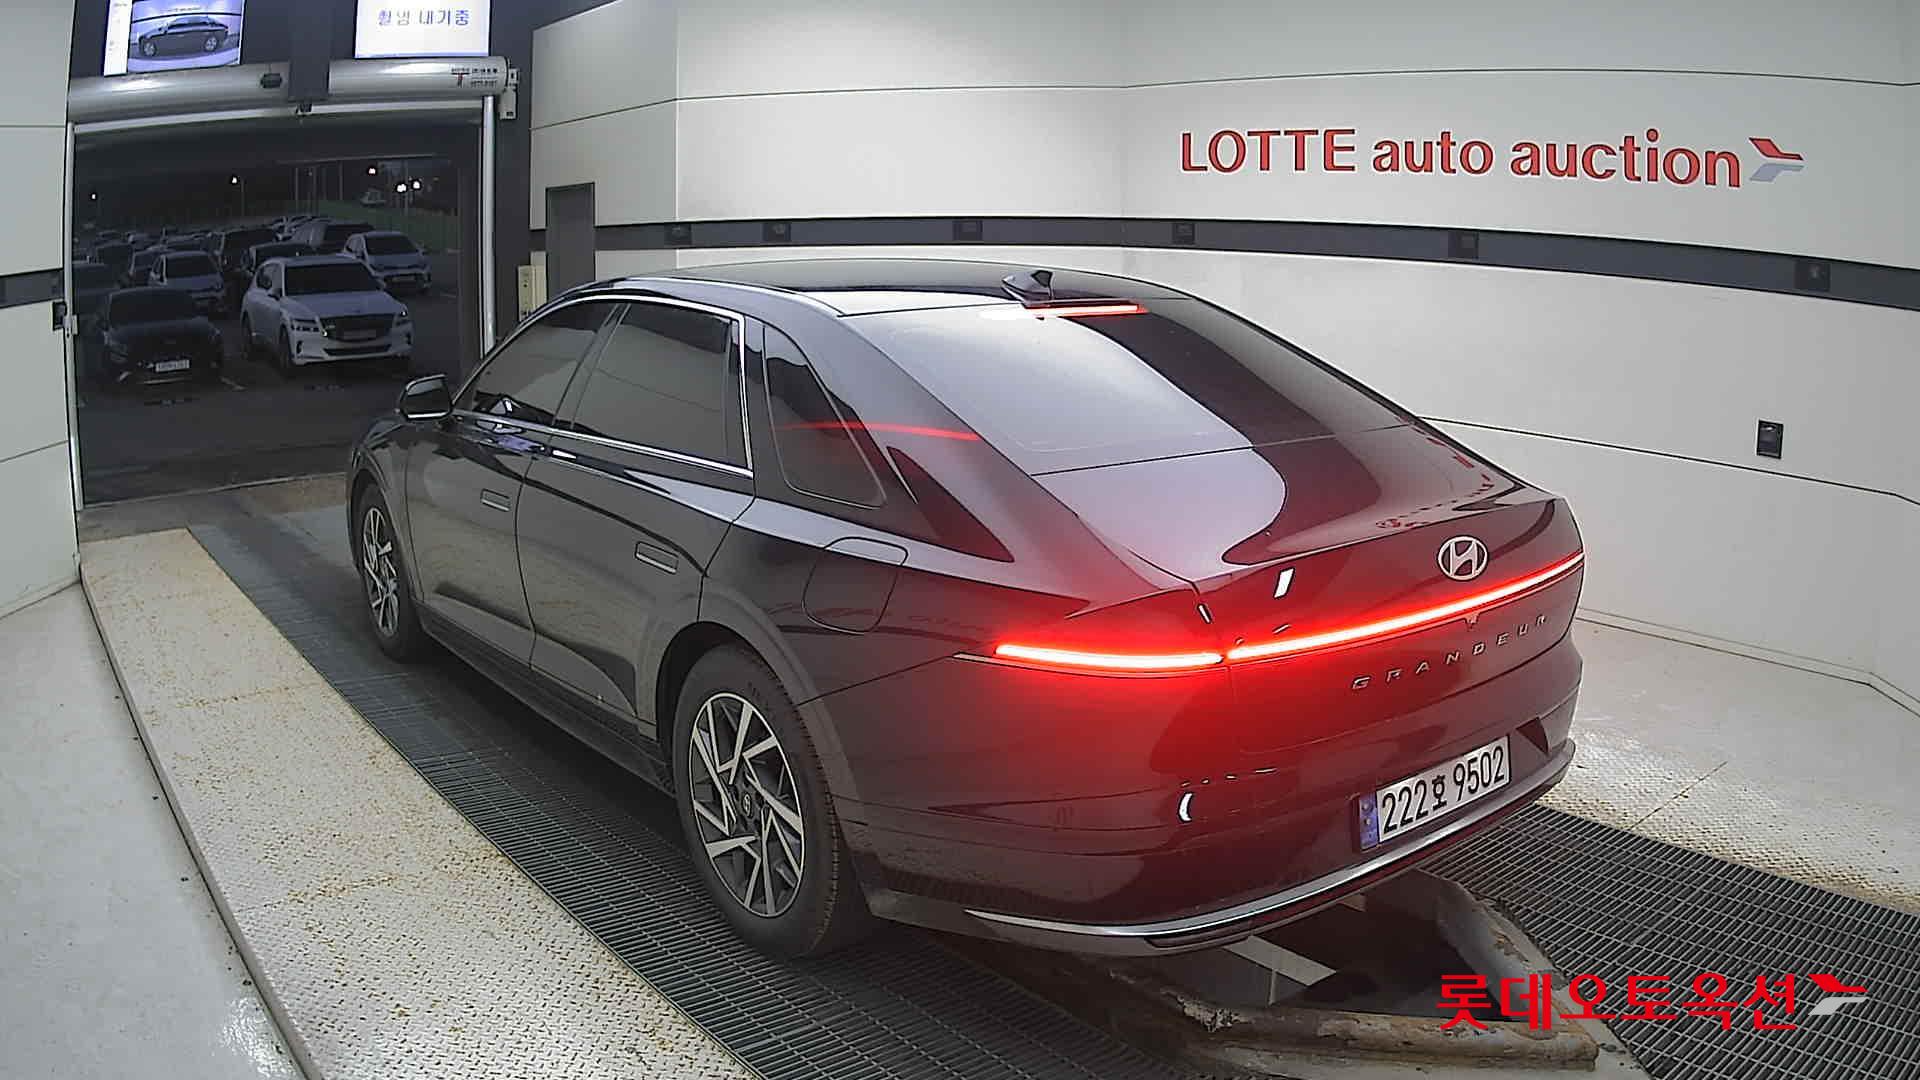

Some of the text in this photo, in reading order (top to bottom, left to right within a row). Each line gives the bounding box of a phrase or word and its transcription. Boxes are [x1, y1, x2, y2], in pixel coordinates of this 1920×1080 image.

[1181, 128, 1741, 188] LOTTE auto auction
[1352, 614, 1547, 690] GRANDEUR
[1382, 745, 1505, 835] 222호 9502
